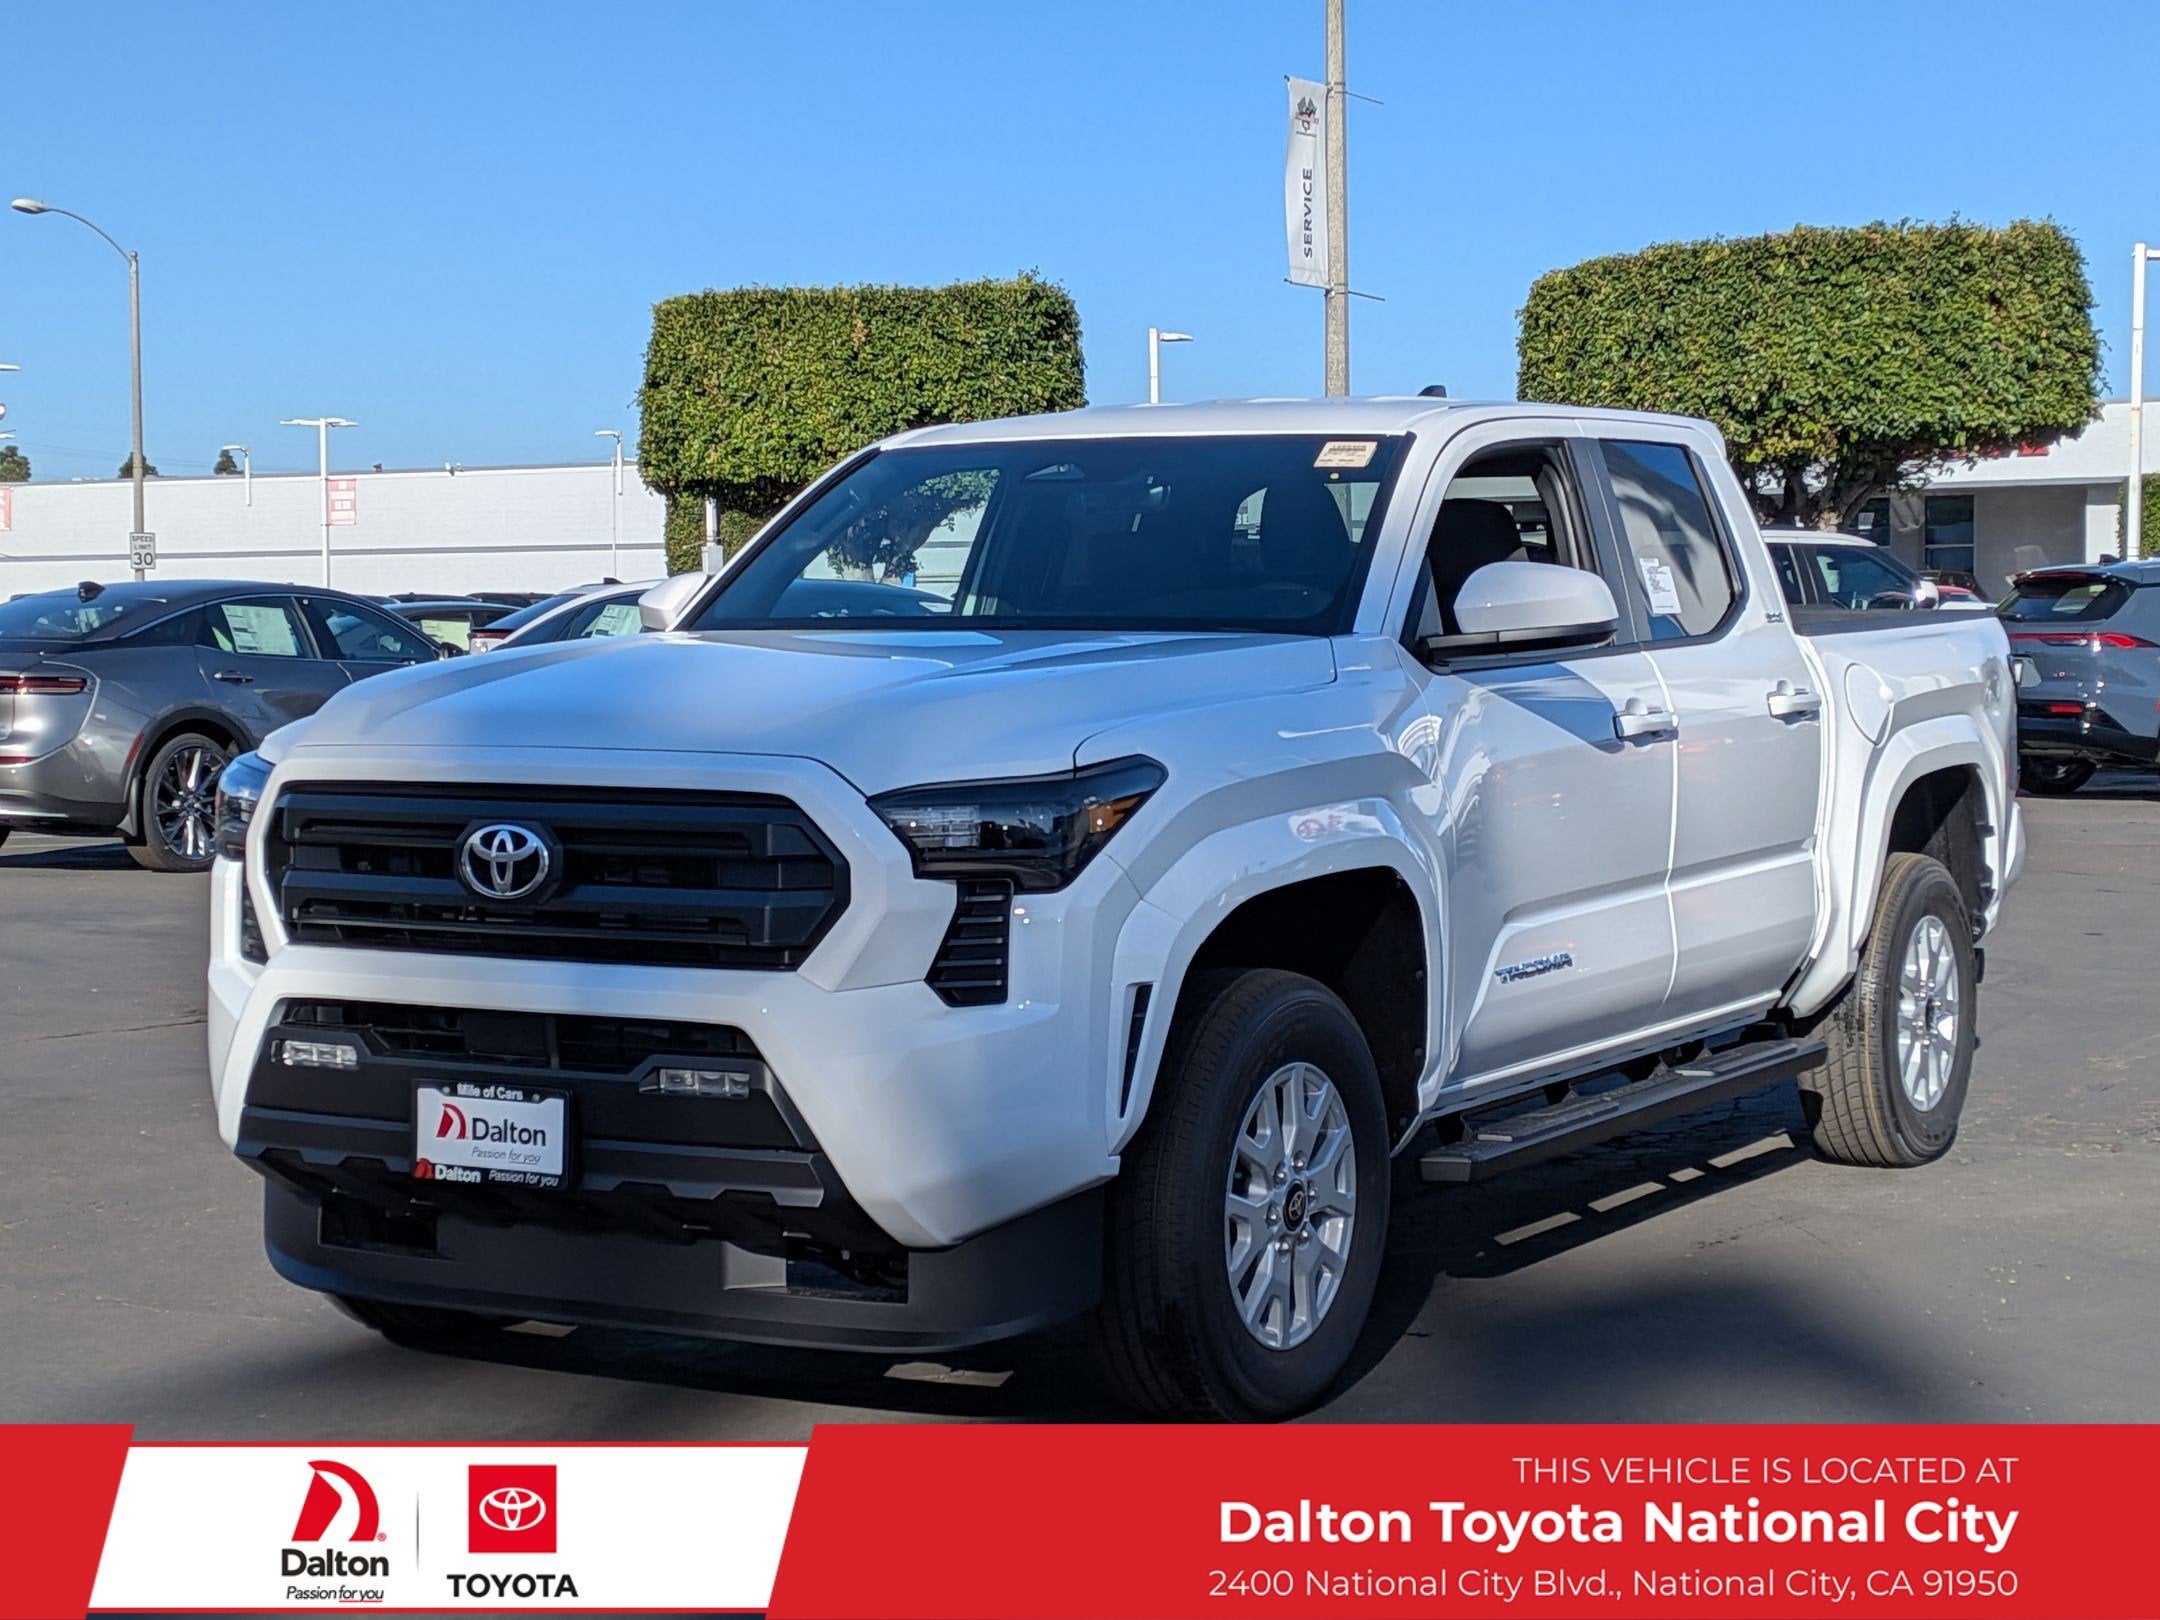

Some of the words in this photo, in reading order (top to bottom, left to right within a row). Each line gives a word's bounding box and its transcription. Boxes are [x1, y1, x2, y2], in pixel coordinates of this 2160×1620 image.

[1302, 167, 1313, 259] SERVICE
[133, 552, 153, 566] 30
[456, 1082, 480, 1097] Mile
[482, 1086, 495, 1098] of
[496, 1087, 523, 1100] Cars
[471, 1117, 547, 1147] Dalton
[471, 1146, 507, 1160] Passion
[507, 1148, 522, 1162] for
[522, 1155, 542, 1165] you
[434, 1165, 481, 1183] Dalton
[488, 1169, 524, 1183] Passion
[524, 1172, 540, 1184] for
[539, 1175, 560, 1188] you
